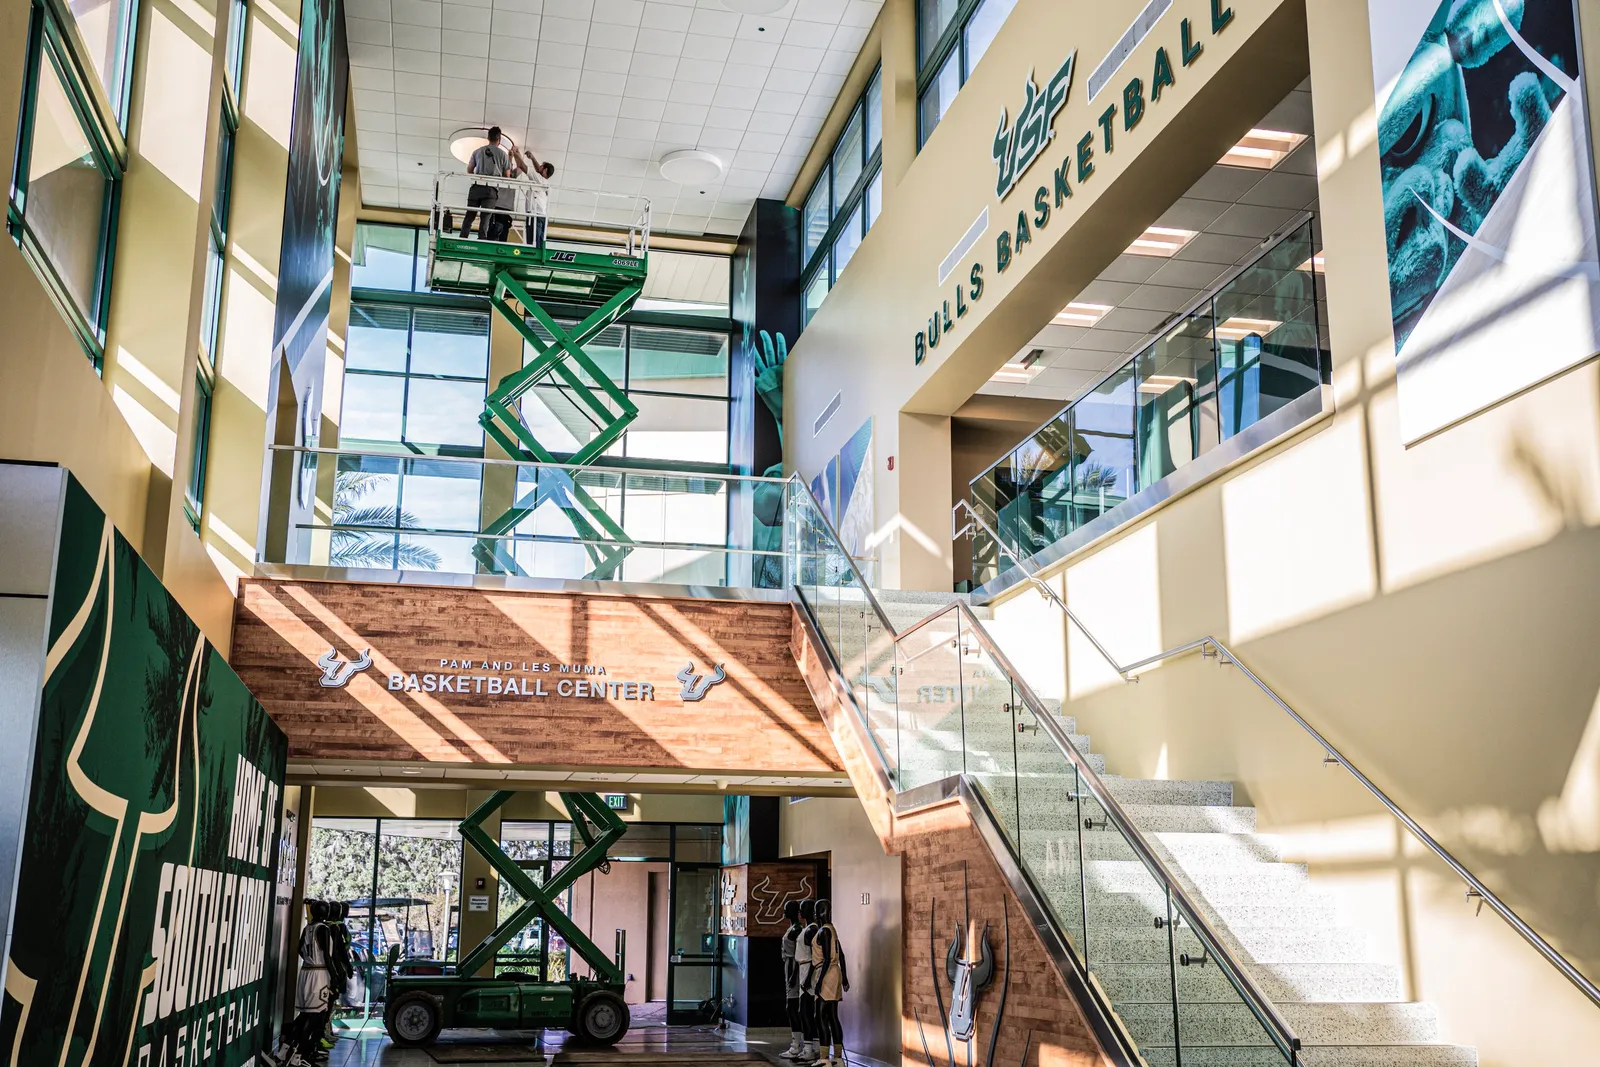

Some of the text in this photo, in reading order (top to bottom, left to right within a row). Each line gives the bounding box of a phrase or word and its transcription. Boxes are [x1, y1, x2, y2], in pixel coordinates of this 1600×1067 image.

[992, 47, 1078, 201] USF
[914, 0, 1234, 366] BULLS BASKETBALL
[550, 252, 576, 262] JLG
[612, 258, 639, 267] 4069LE
[440, 659, 606, 675] PAM AND LES MUMA
[388, 672, 655, 700] BASKETBALL CENTER
[228, 753, 266, 866] HOME
[261, 780, 278, 868] OF
[609, 796, 624, 807] EXIT
[142, 862, 270, 1027] SOUTH FLORIDA
